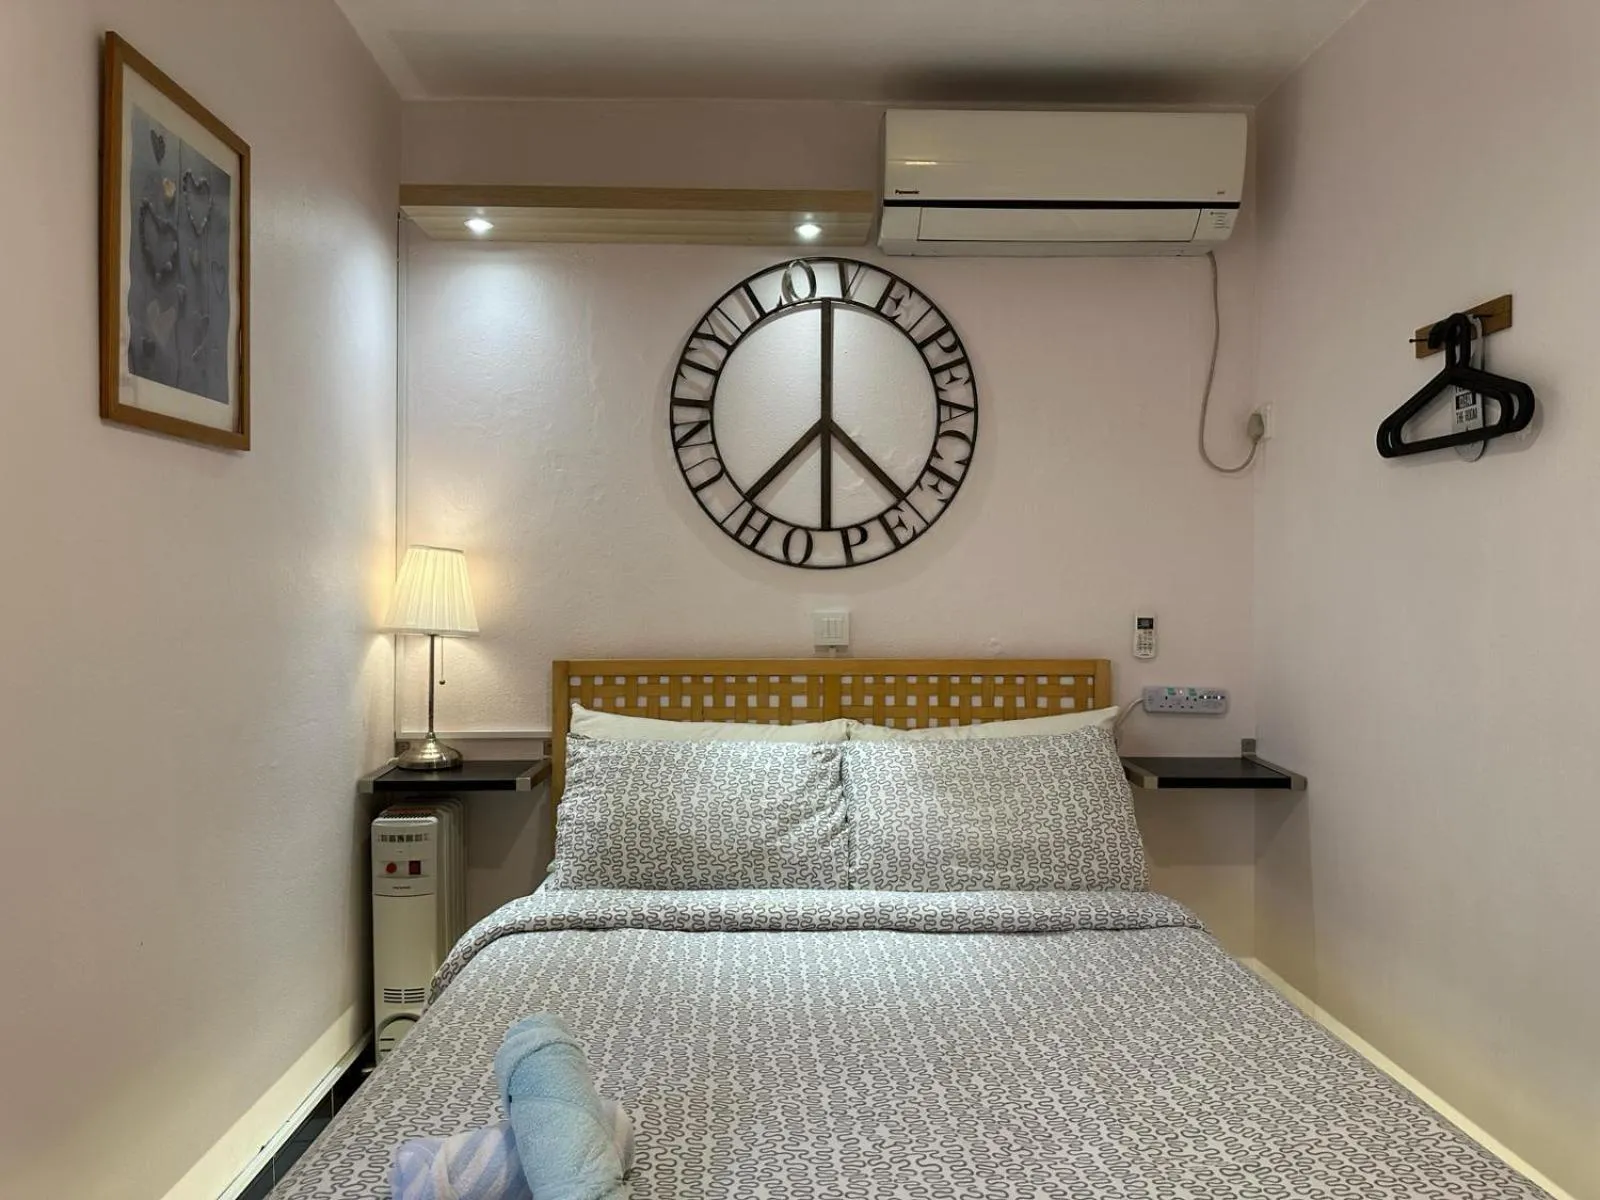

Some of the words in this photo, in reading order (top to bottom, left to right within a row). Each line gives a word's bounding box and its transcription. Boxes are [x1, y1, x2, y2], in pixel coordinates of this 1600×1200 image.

[741, 258, 914, 320] LOVE
[671, 317, 732, 493] UNITY
[915, 322, 975, 504] PEACE
[735, 505, 917, 565] HOPE
